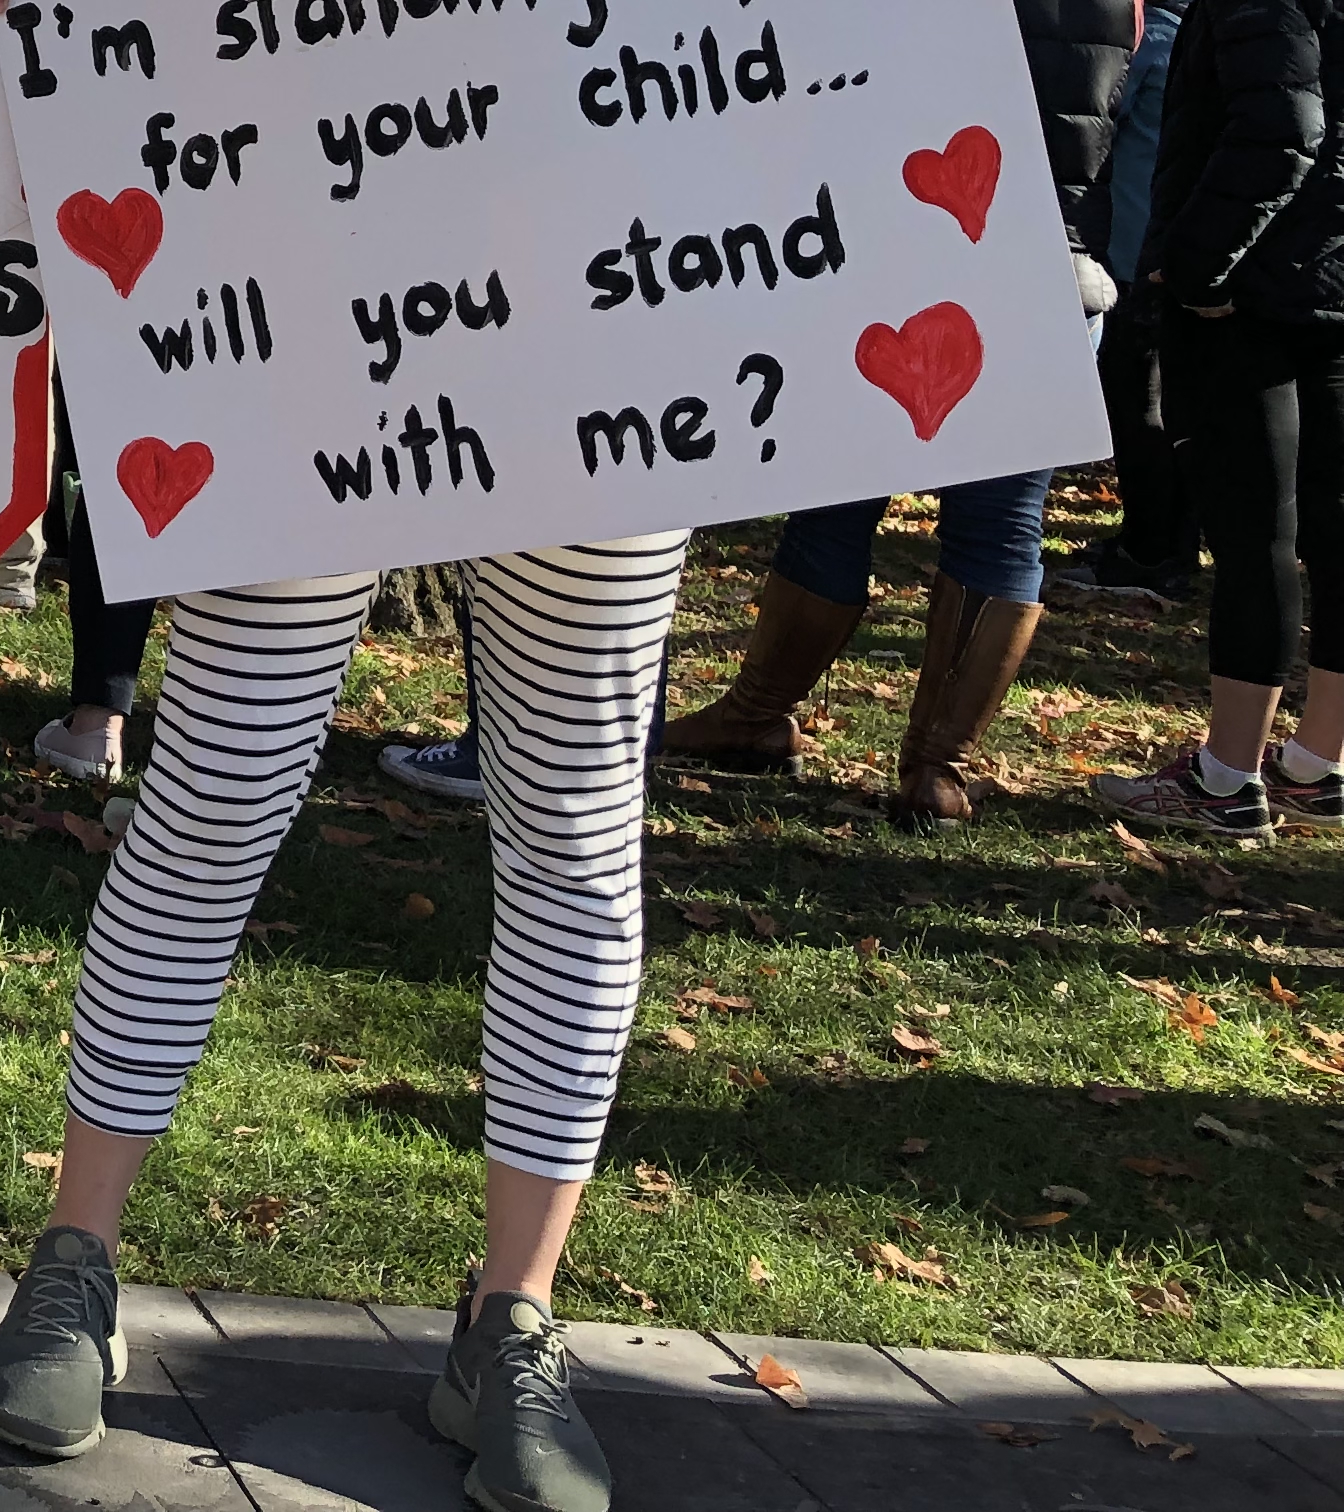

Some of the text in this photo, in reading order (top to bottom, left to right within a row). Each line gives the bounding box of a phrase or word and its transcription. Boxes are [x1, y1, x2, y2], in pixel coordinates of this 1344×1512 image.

[6, 1, 157, 99] I'm
[141, 111, 260, 196] for
[318, 80, 500, 202] your
[138, 182, 846, 385] will you stand
[314, 353, 785, 504] with me?
